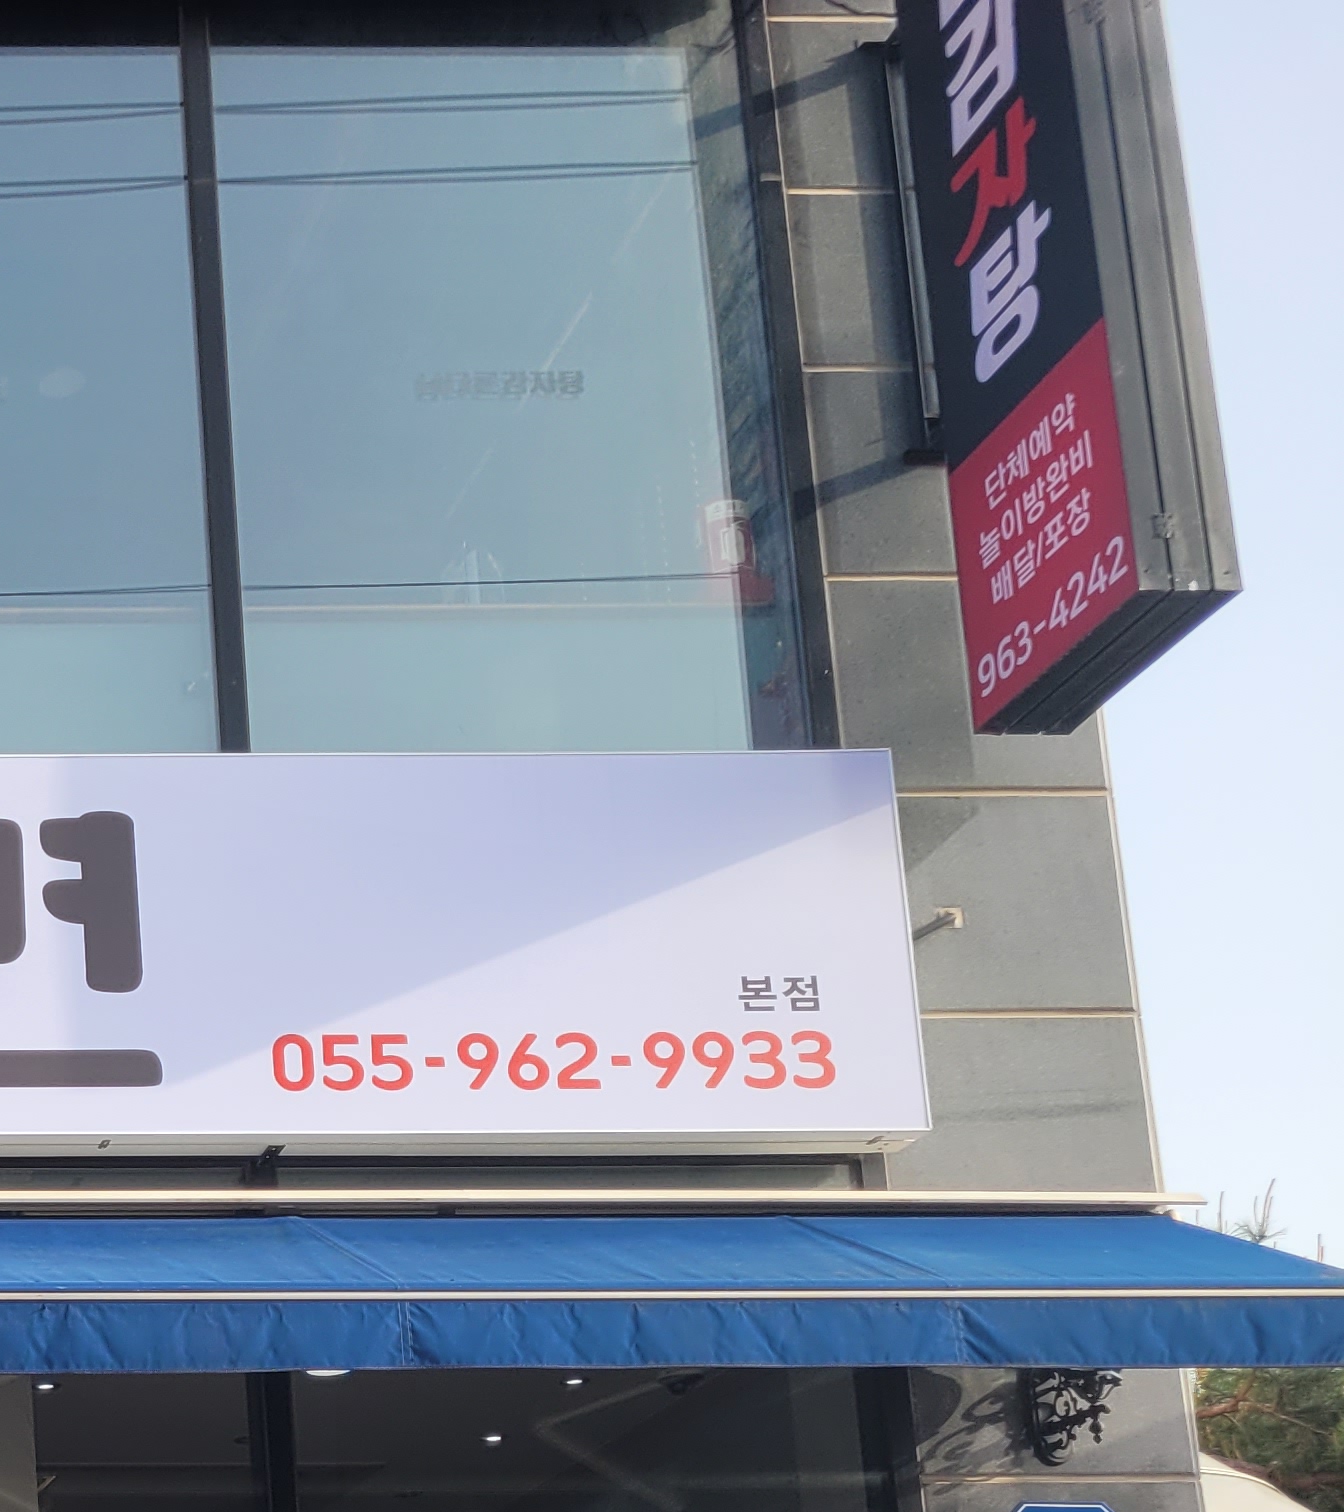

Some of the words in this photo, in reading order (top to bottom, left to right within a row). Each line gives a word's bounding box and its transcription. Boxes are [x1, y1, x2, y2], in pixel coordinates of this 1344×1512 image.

[939, 0, 1052, 383] 감자탕
[978, 429, 1093, 570] 놀이방완비
[984, 392, 1077, 511] 단체예약
[990, 487, 1092, 605] 배달/포장
[977, 535, 1129, 698] 963-4242
[738, 975, 821, 1012] 본점
[271, 1031, 837, 1092] 055-962-9933
